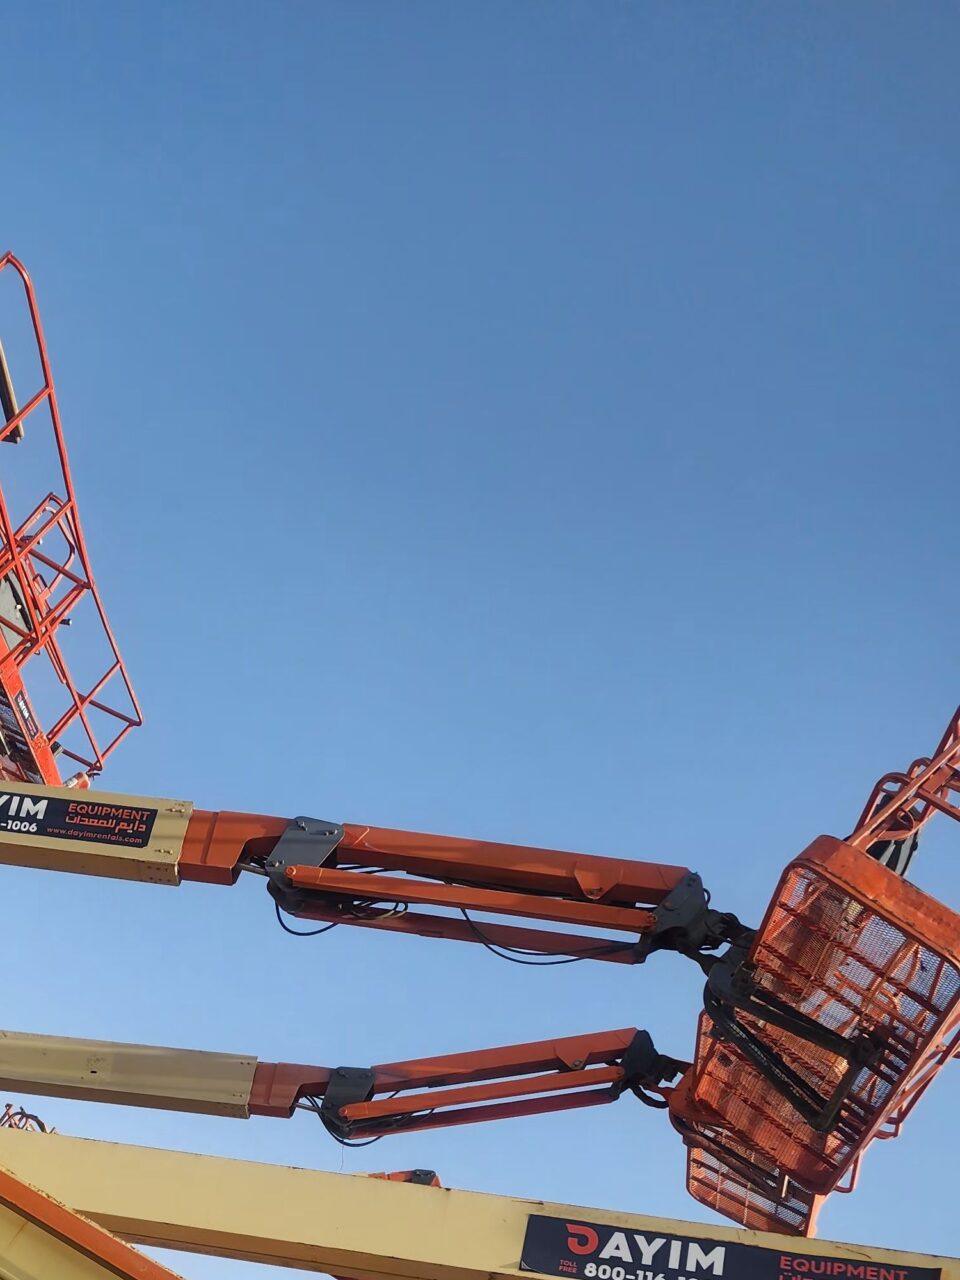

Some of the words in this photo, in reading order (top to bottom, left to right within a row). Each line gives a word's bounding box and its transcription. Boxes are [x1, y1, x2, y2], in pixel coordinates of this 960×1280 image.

[68, 802, 151, 822] EQUIPMENT
[46, 826, 143, 844] www.dayimrentals.com
[566, 1223, 727, 1276] DAYIM
[558, 1265, 577, 1274] FREE
[559, 1259, 577, 1267] TOLL
